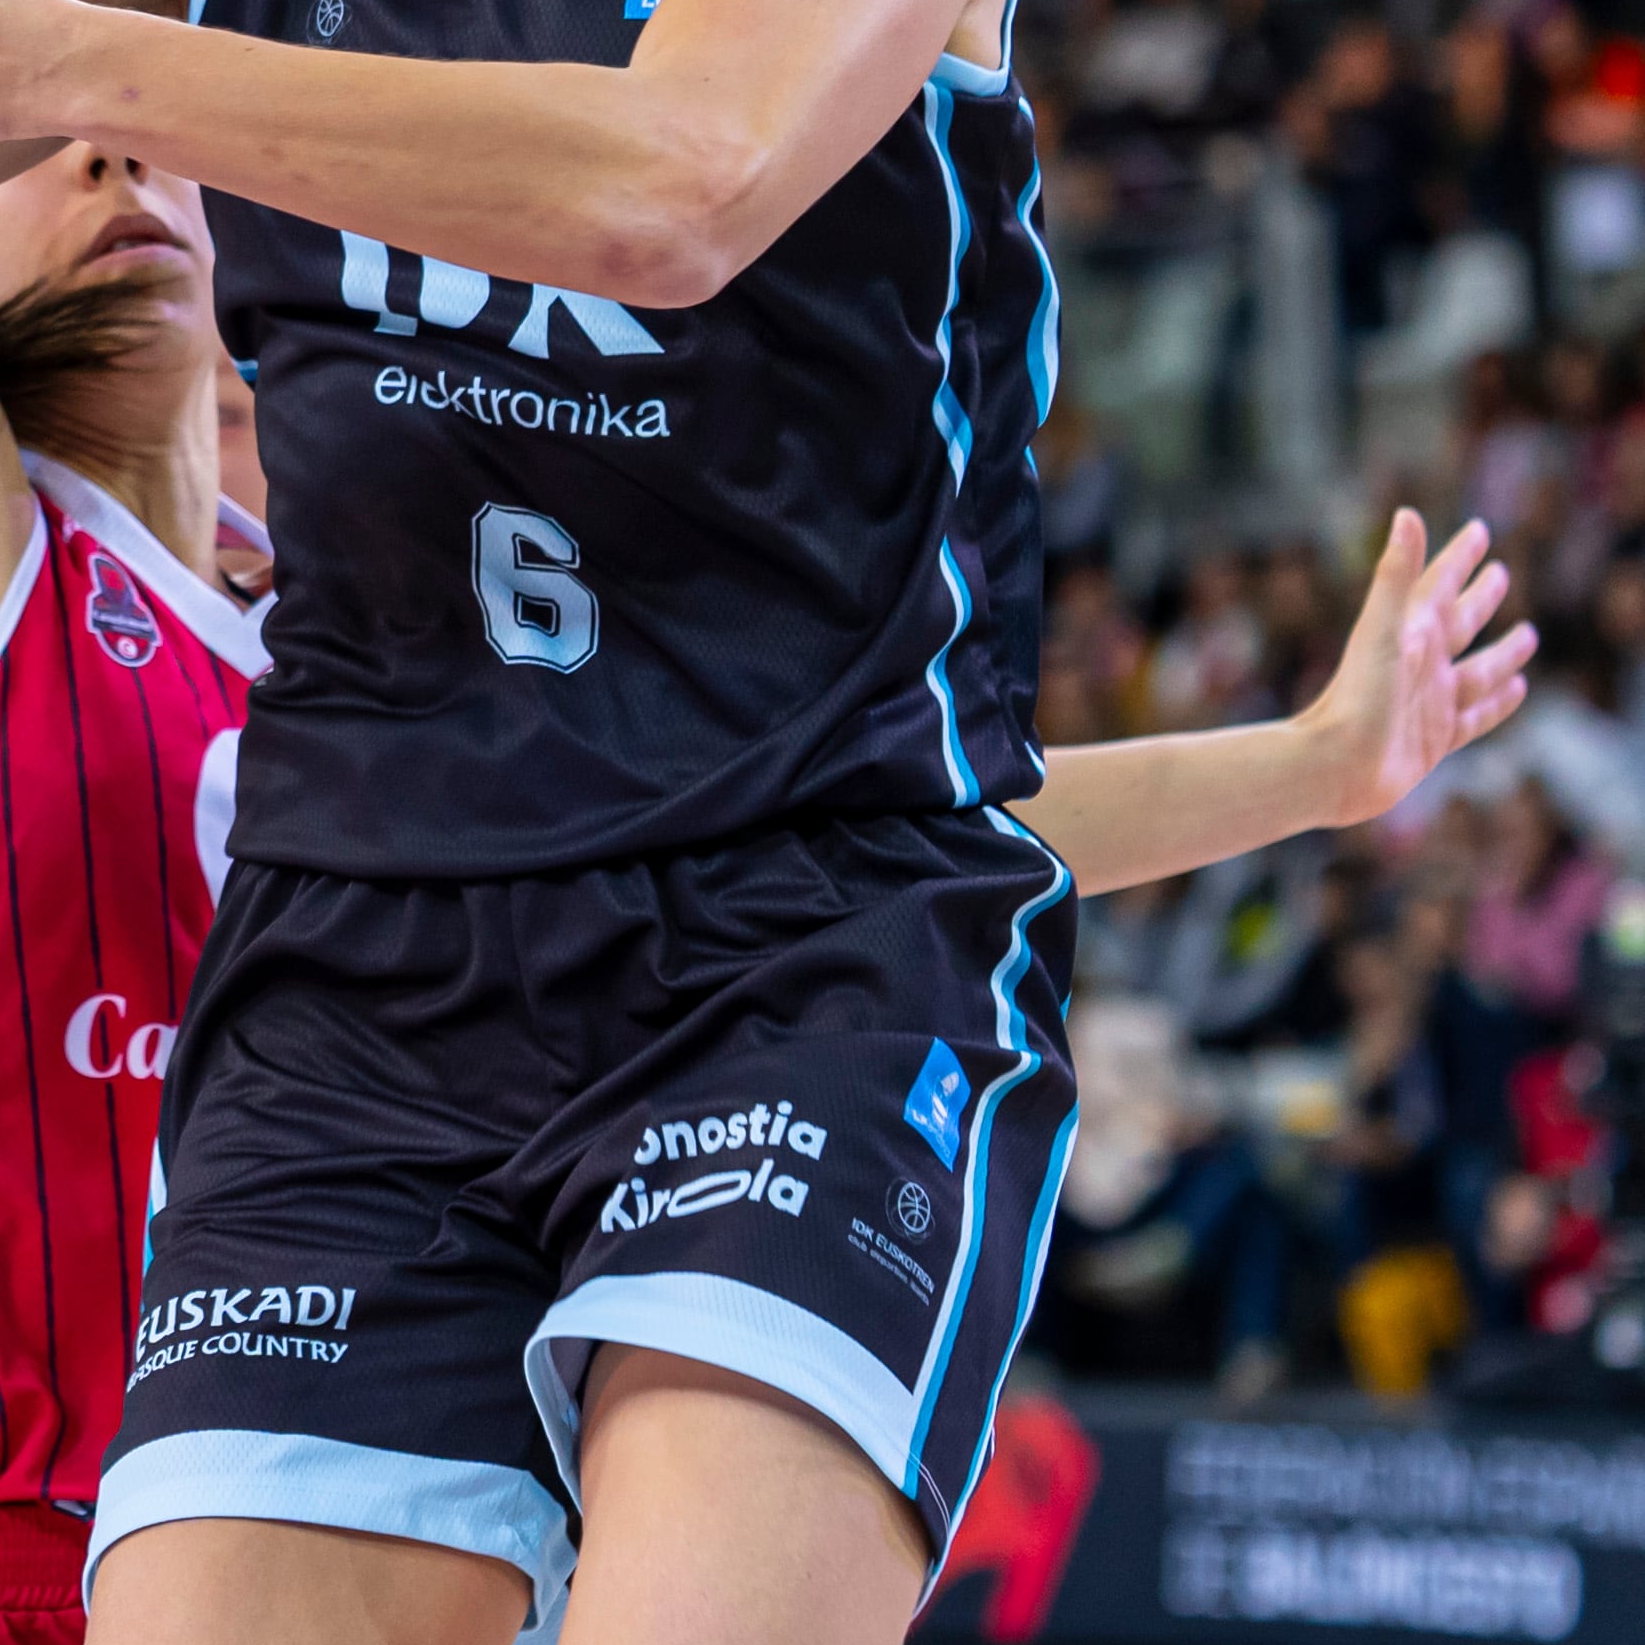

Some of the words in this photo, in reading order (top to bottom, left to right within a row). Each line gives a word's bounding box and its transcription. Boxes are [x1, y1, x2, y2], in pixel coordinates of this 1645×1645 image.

[471, 501, 599, 674] 6
[63, 992, 179, 1080] Ca
[135, 1285, 358, 1363] EUSKADI
[201, 1331, 350, 1365] COUNTRY
